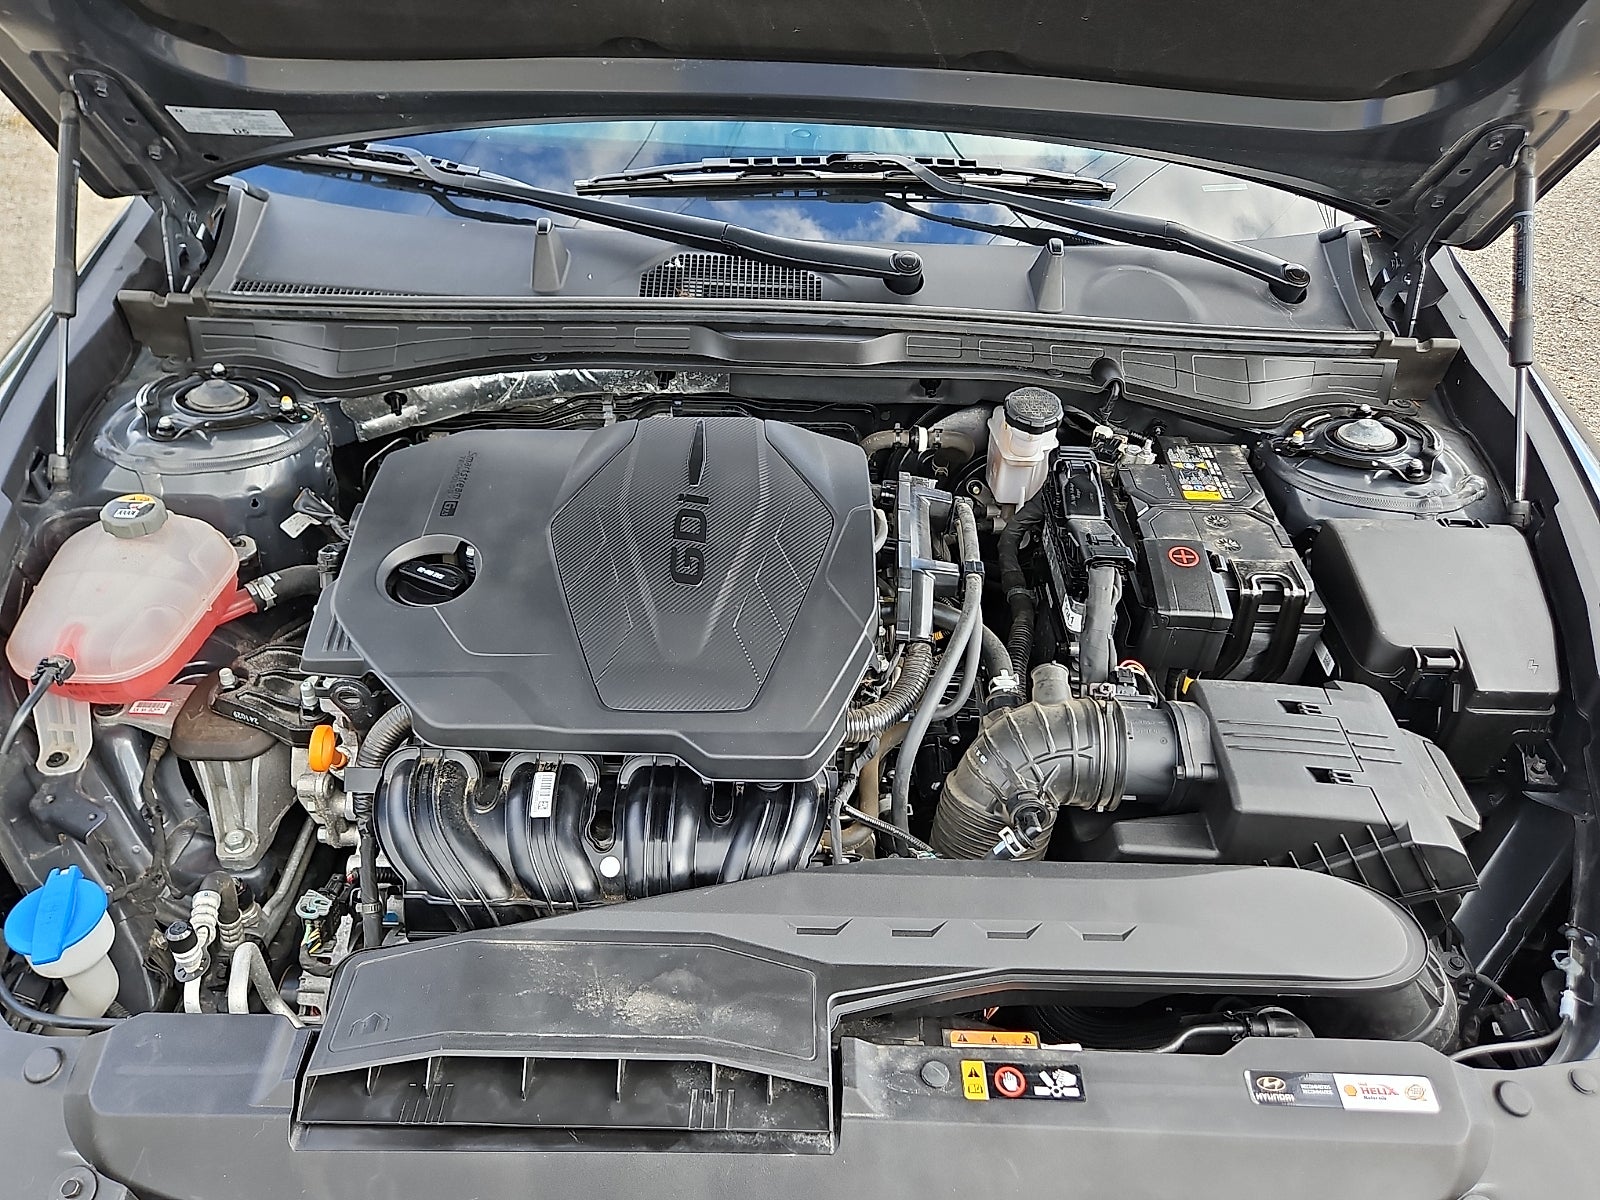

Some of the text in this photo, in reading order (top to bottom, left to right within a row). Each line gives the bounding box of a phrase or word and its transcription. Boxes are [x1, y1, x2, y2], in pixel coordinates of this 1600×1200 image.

[453, 451, 477, 499] Smartstream
[670, 493, 709, 585] GDi
[1255, 1092, 1295, 1102] HYUNDAI
[1359, 1086, 1399, 1096] HELIX
